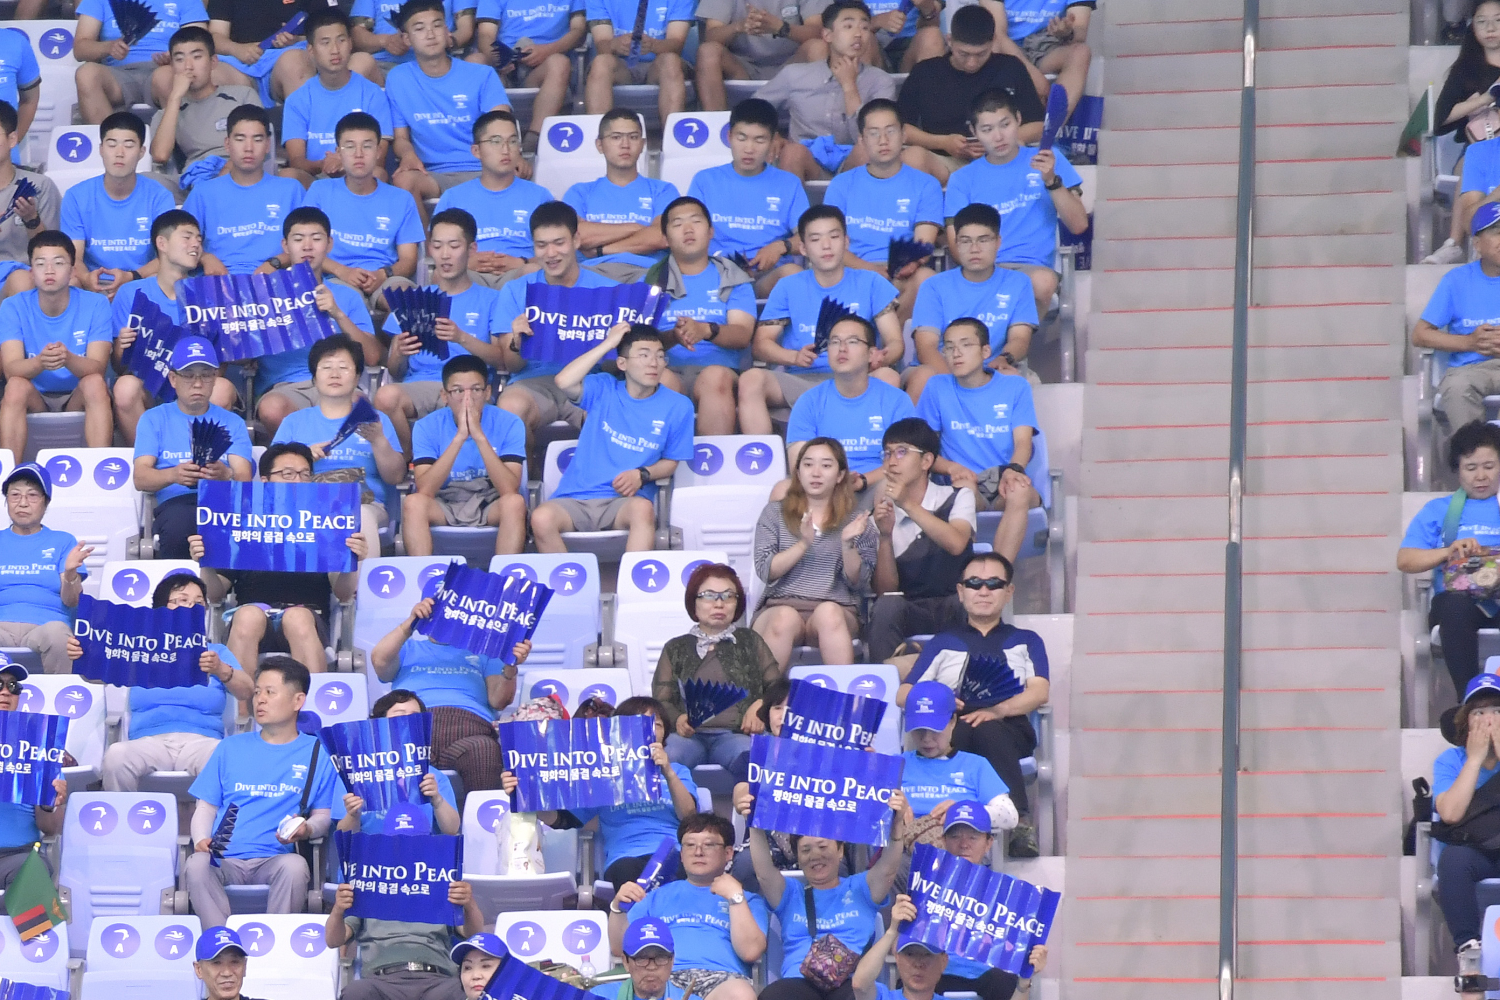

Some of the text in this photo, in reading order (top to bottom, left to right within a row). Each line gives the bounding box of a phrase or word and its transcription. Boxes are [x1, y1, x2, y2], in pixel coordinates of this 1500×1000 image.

[185, 289, 318, 325] DIVE INTO PEAC
[222, 315, 293, 334] 평화의 물결 속으로
[197, 507, 355, 529] DIVE INTO PEACE
[232, 530, 315, 543] 평화의 물결 속으로
[74, 619, 112, 645] DIVE
[118, 634, 157, 651] INTO
[105, 647, 177, 663] 평화의 물결 속으로
[508, 742, 652, 769] DIVE INTO PEAC
[540, 766, 620, 782] 평화의 물결 속으로
[748, 763, 894, 802] DIVE INTO PEAC
[234, 782, 256, 792] DIVE
[257, 784, 278, 792] INTO
[773, 791, 856, 812] 평화의 물결 속으로
[926, 900, 1005, 938] 평화의 물결 속으로
[941, 888, 988, 915] INTO
[991, 903, 1044, 937] PEACE
[521, 941, 530, 950] A
